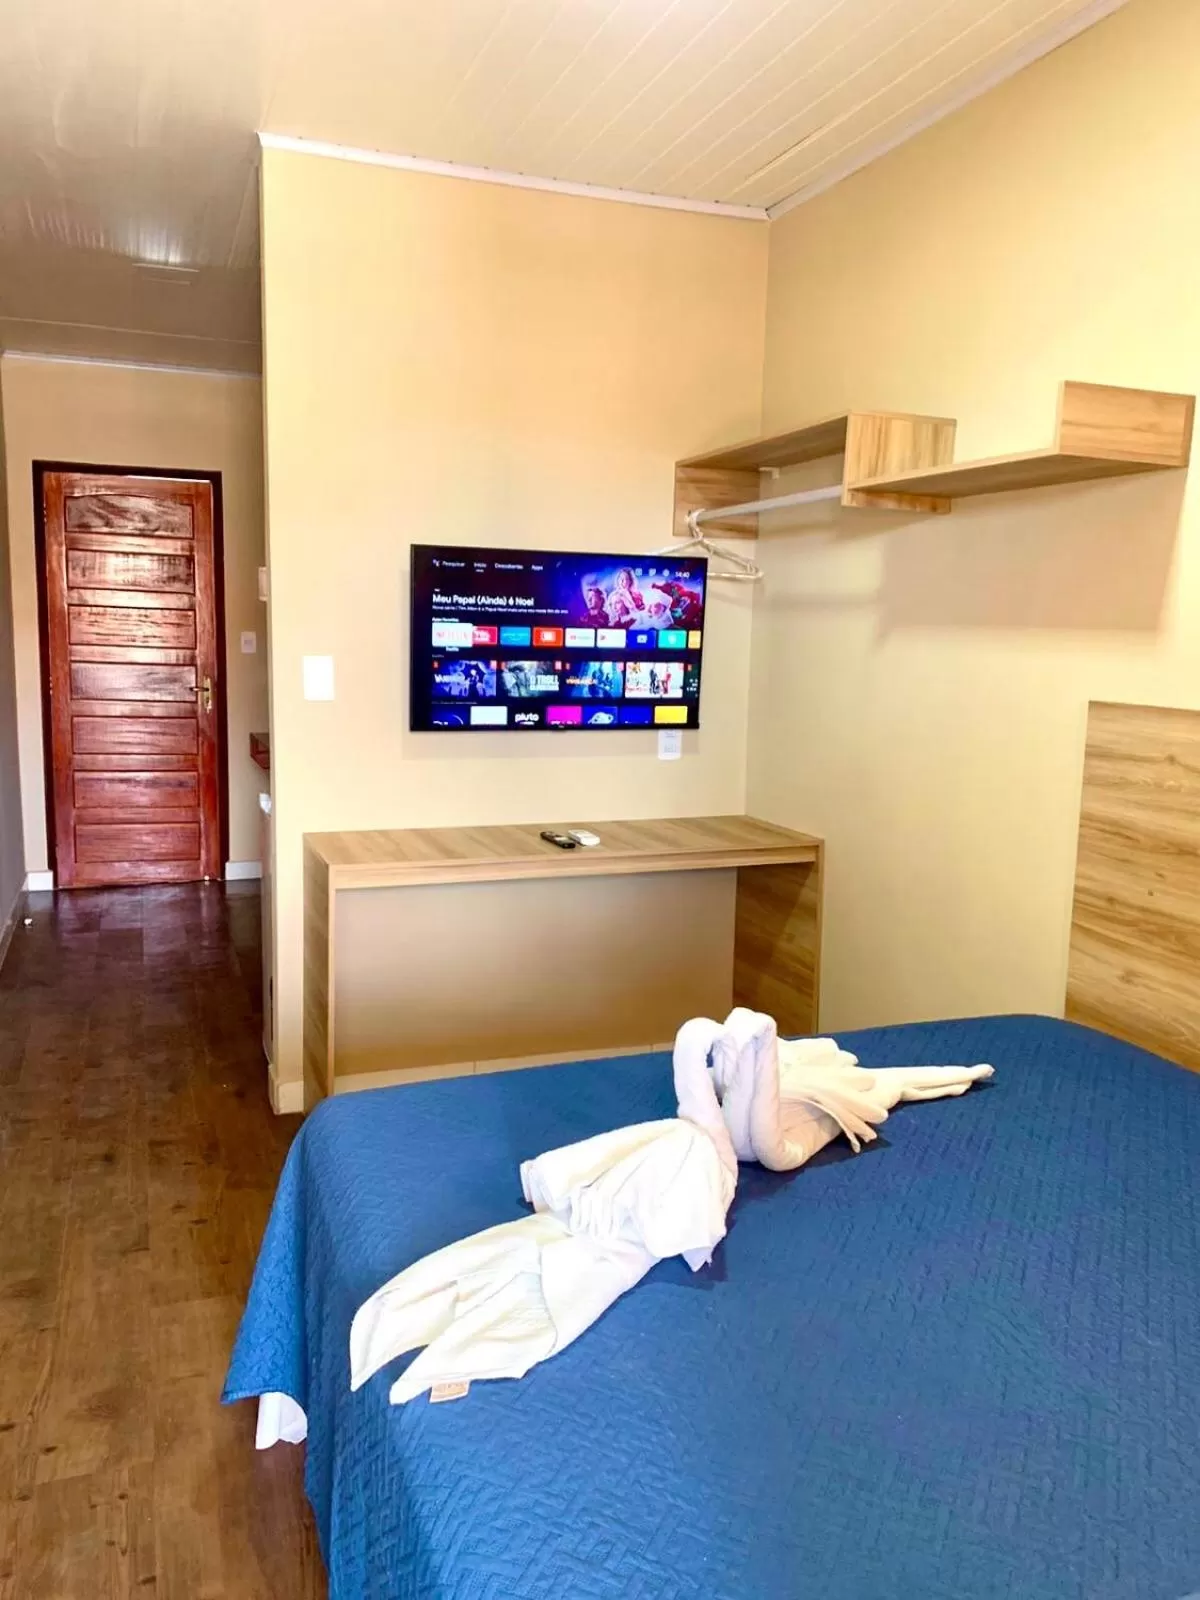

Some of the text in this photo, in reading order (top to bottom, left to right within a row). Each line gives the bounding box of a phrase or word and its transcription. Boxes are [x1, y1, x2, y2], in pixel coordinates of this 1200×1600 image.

[432, 594, 451, 603] Meu
[453, 594, 476, 605] Papai
[477, 595, 507, 606] (Ainda)
[515, 597, 534, 606] Noel
[515, 713, 539, 723] pluto
